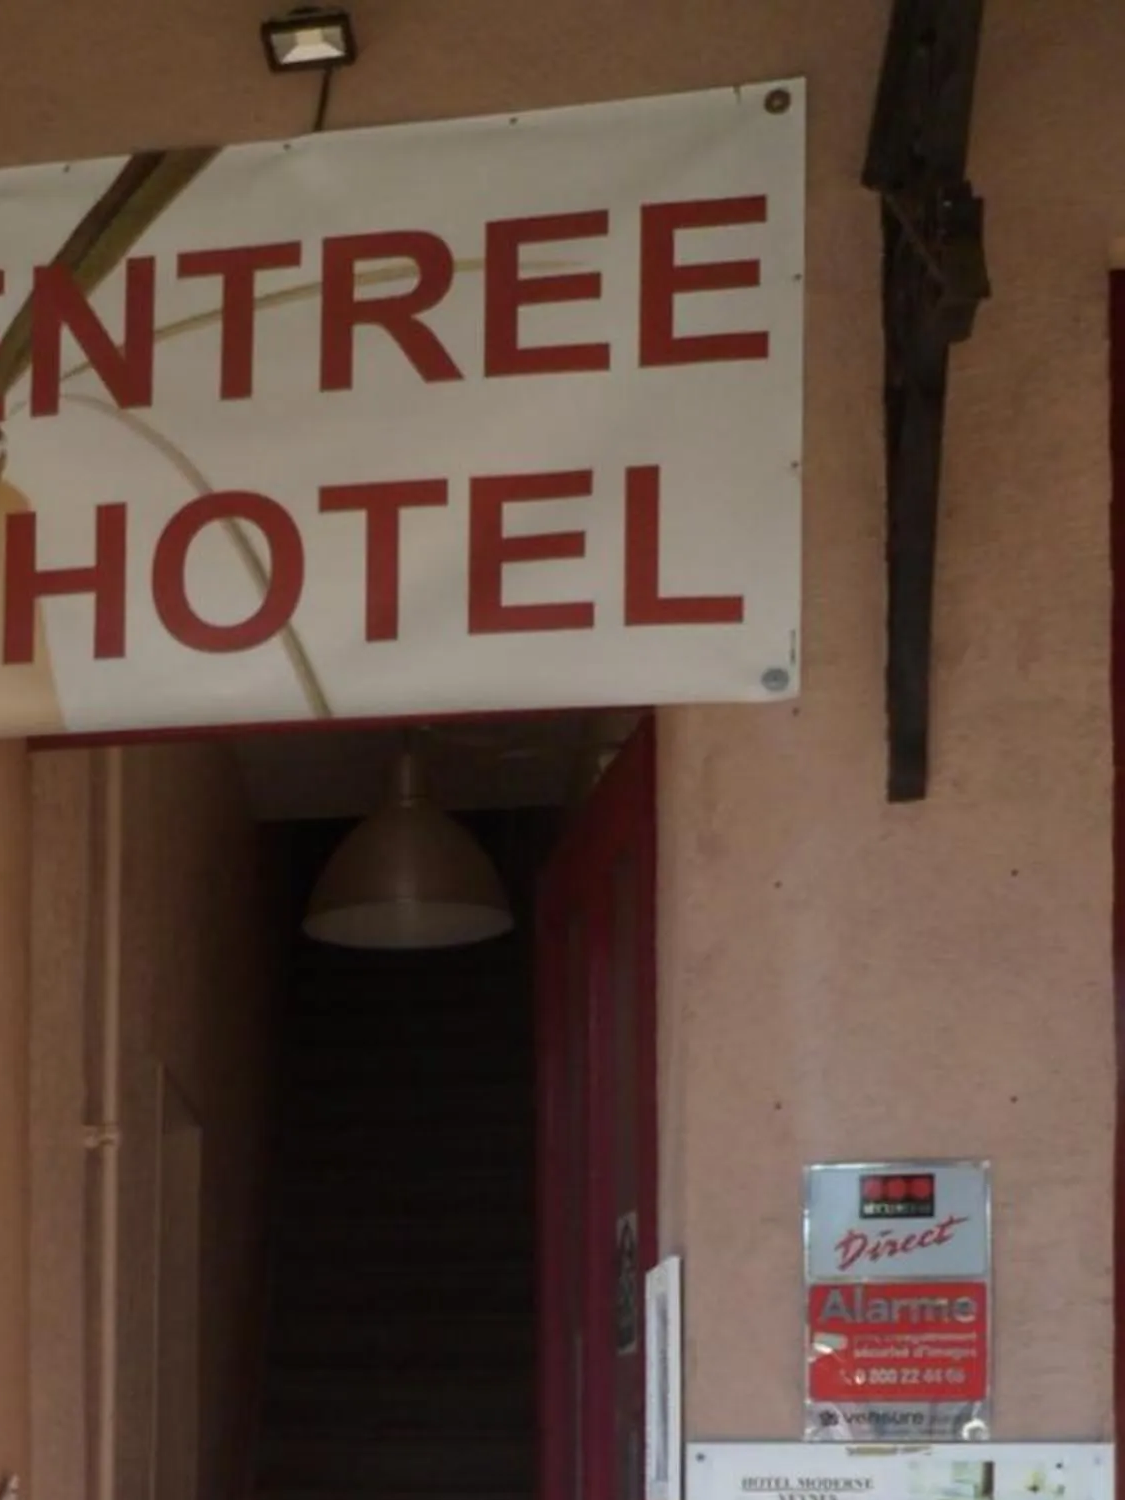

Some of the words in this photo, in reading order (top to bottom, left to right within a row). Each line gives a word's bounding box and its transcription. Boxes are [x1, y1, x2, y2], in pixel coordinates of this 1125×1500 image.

[1, 465, 745, 666] HOTEL
[835, 1215, 969, 1271] Direct
[819, 1285, 977, 1325] Alarme
